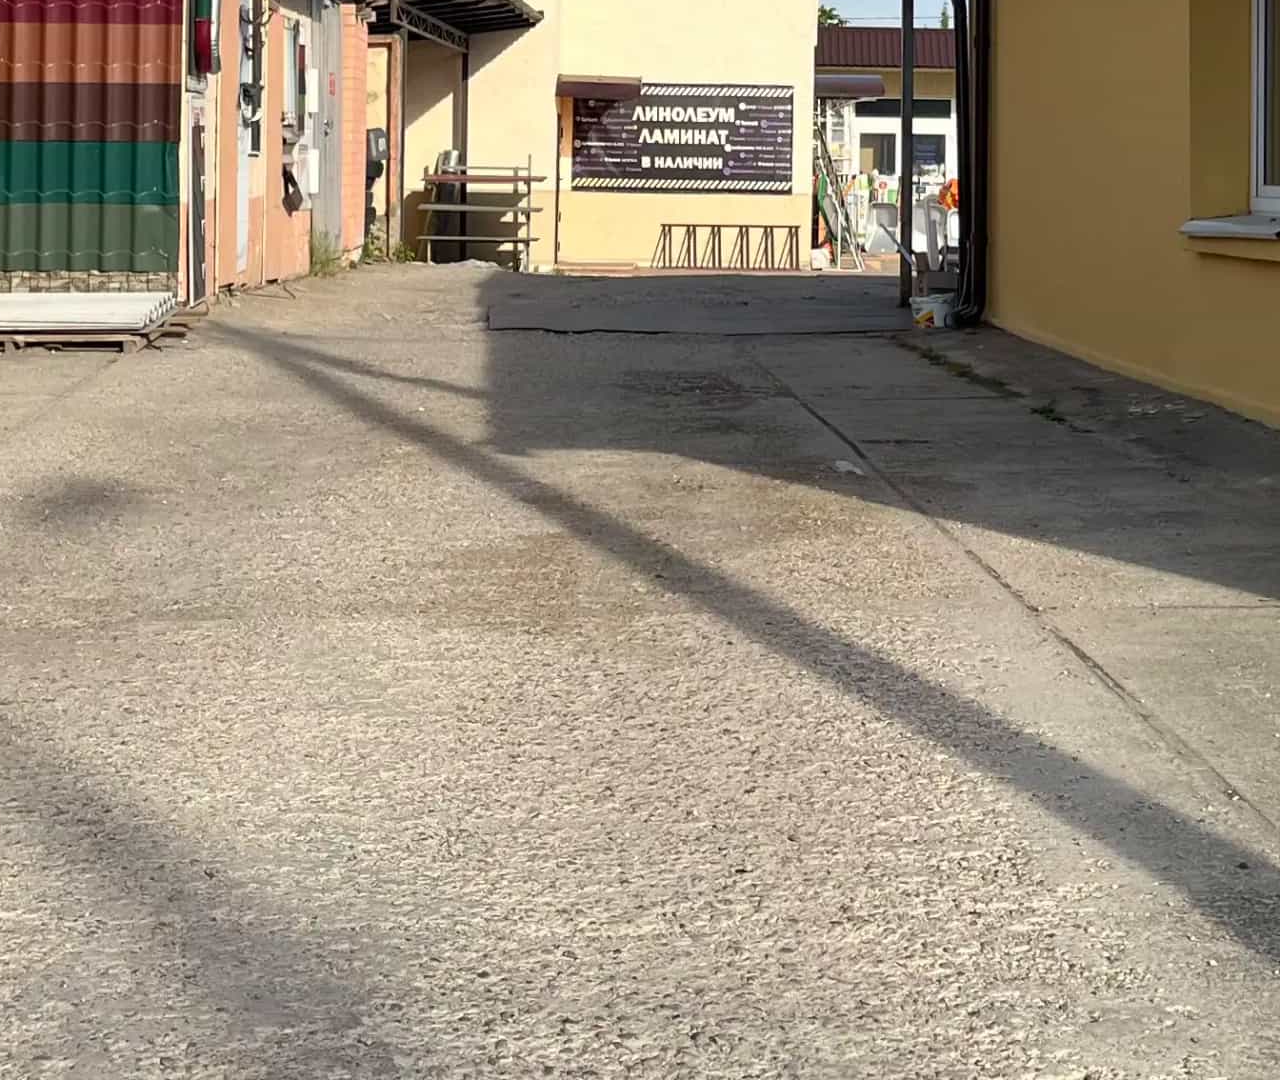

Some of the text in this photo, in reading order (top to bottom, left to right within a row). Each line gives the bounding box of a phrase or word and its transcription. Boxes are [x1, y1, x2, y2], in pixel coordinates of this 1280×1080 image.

[631, 105, 736, 123] ЛИНОЛЕУМ
[638, 128, 729, 145] ЛАМИНАТ
[641, 156, 723, 170] В НАЛИЧИИ
